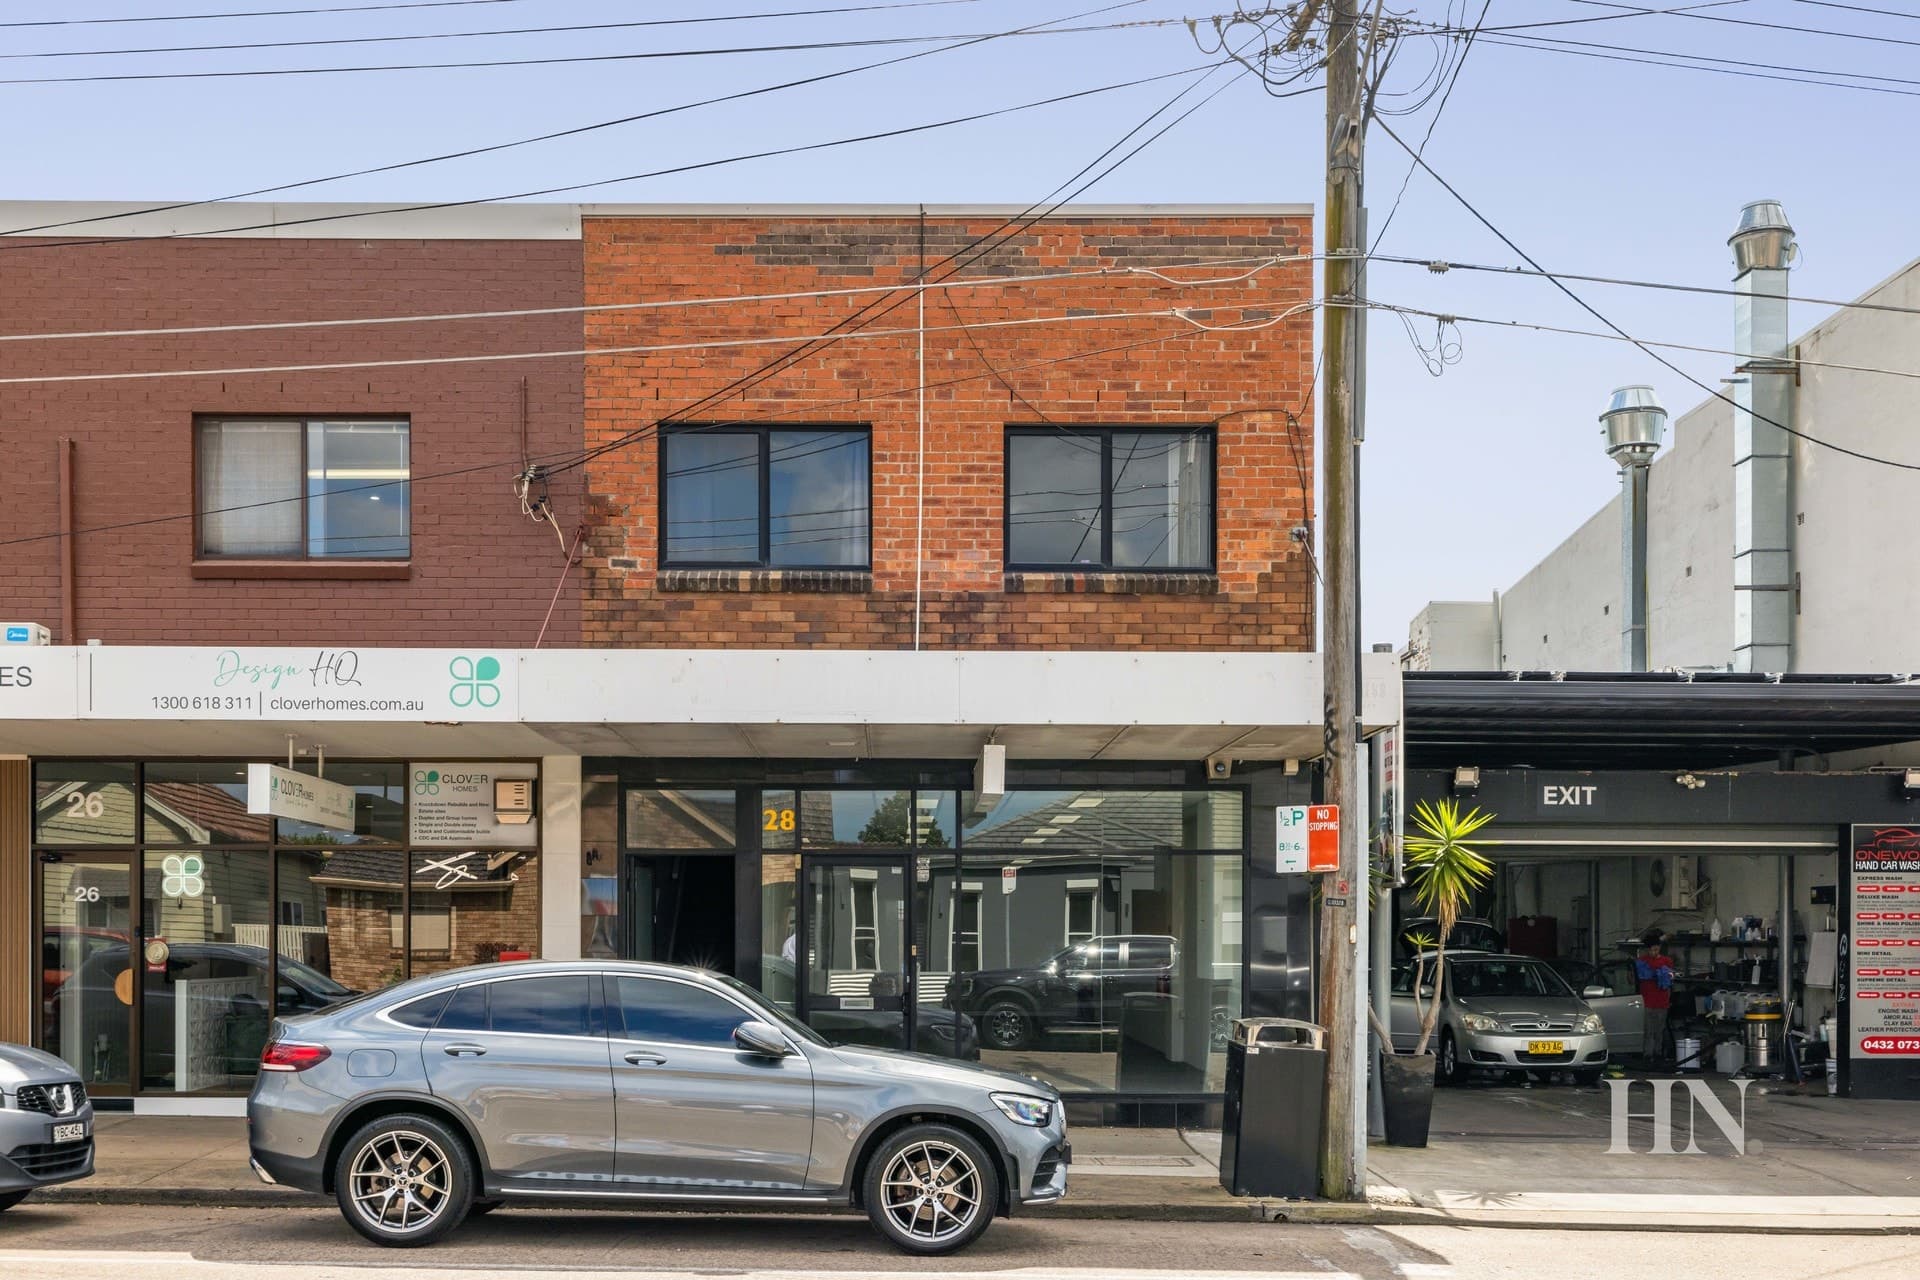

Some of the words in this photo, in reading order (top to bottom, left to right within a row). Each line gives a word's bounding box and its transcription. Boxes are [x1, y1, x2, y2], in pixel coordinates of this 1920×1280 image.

[214, 650, 304, 690] Design
[309, 650, 362, 687] HQ
[152, 696, 188, 709] 1300
[192, 696, 220, 709] 618
[225, 696, 251, 709] 311
[270, 697, 424, 711] cloverhomes.com.au
[442, 774, 488, 784] CLOVER
[1544, 786, 1598, 805] EXIT
[67, 792, 104, 818] 26
[764, 809, 795, 831] 28
[1317, 809, 1329, 819] NO
[1309, 822, 1338, 831] STOPPING
[1856, 850, 1920, 860] ONEWO
[1856, 861, 1878, 870] HAND
[1881, 861, 1898, 870] CAR
[74, 887, 100, 902] 26
[1864, 1040, 1894, 1049] 0432
[1898, 1040, 1920, 1049] 073
